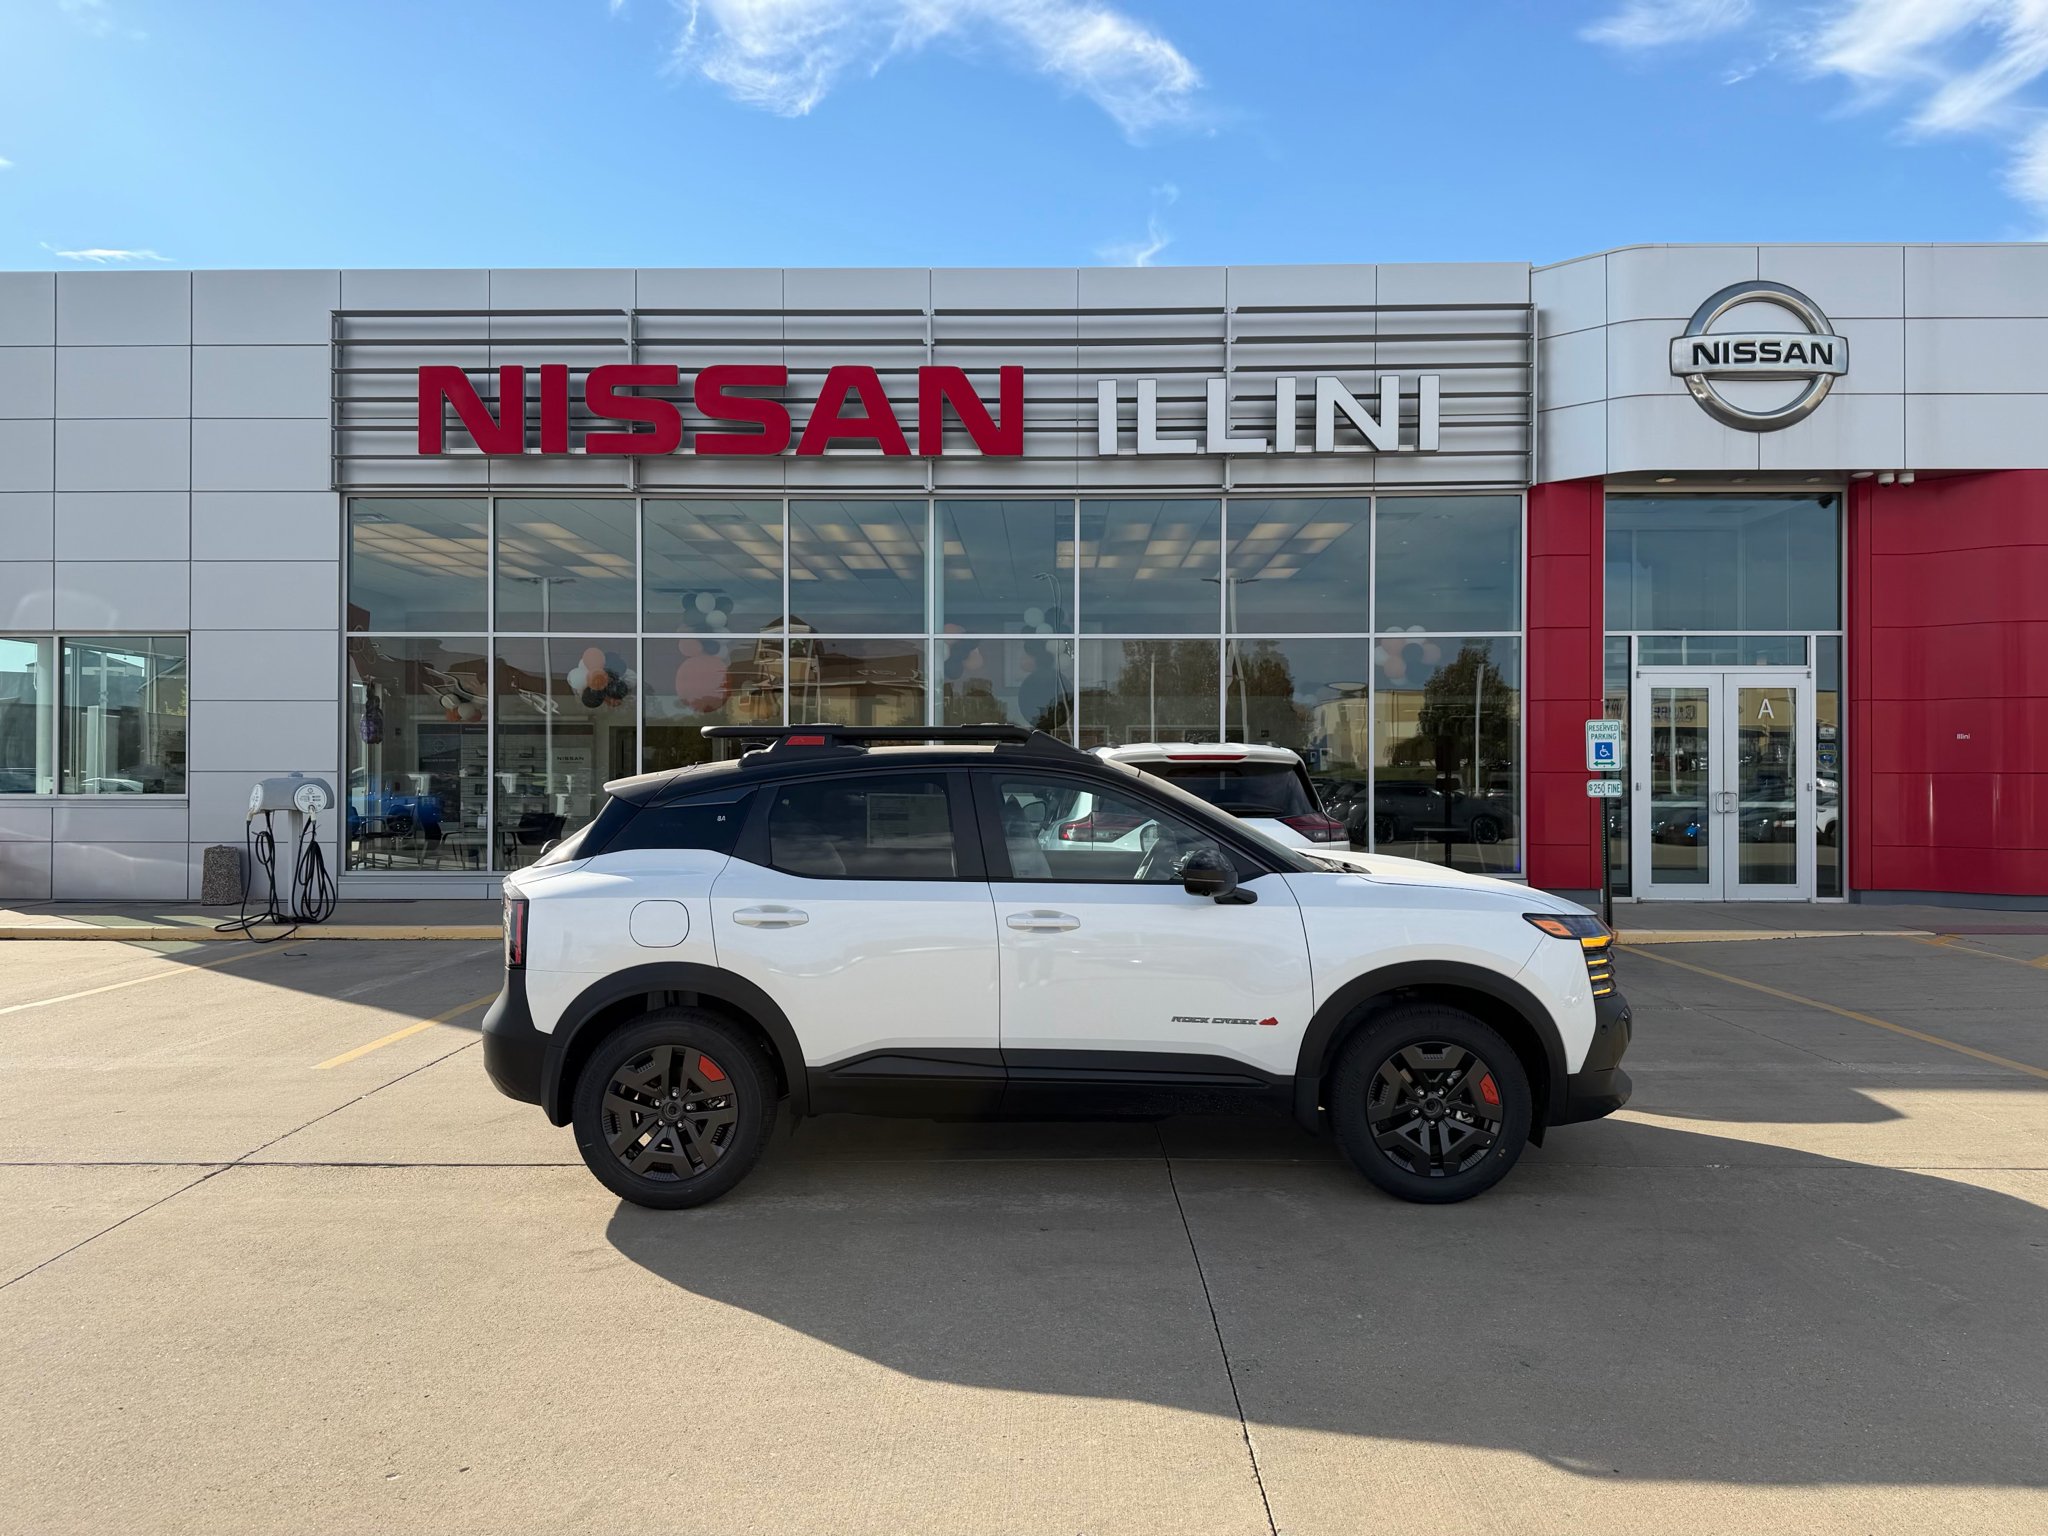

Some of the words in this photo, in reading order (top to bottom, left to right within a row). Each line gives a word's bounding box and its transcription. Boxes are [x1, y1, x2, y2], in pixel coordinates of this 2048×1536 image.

[1692, 341, 1833, 366] NISSAN
[418, 364, 1024, 457] NISSAN
[1097, 374, 1440, 456] ILLINI
[1757, 698, 1774, 719] A
[1588, 724, 1619, 732] RESERVED
[1588, 783, 1606, 794] $250
[1607, 783, 1620, 794] FINE
[1171, 1016, 1211, 1024] ROCK
[1211, 1017, 1258, 1025] CREEK
